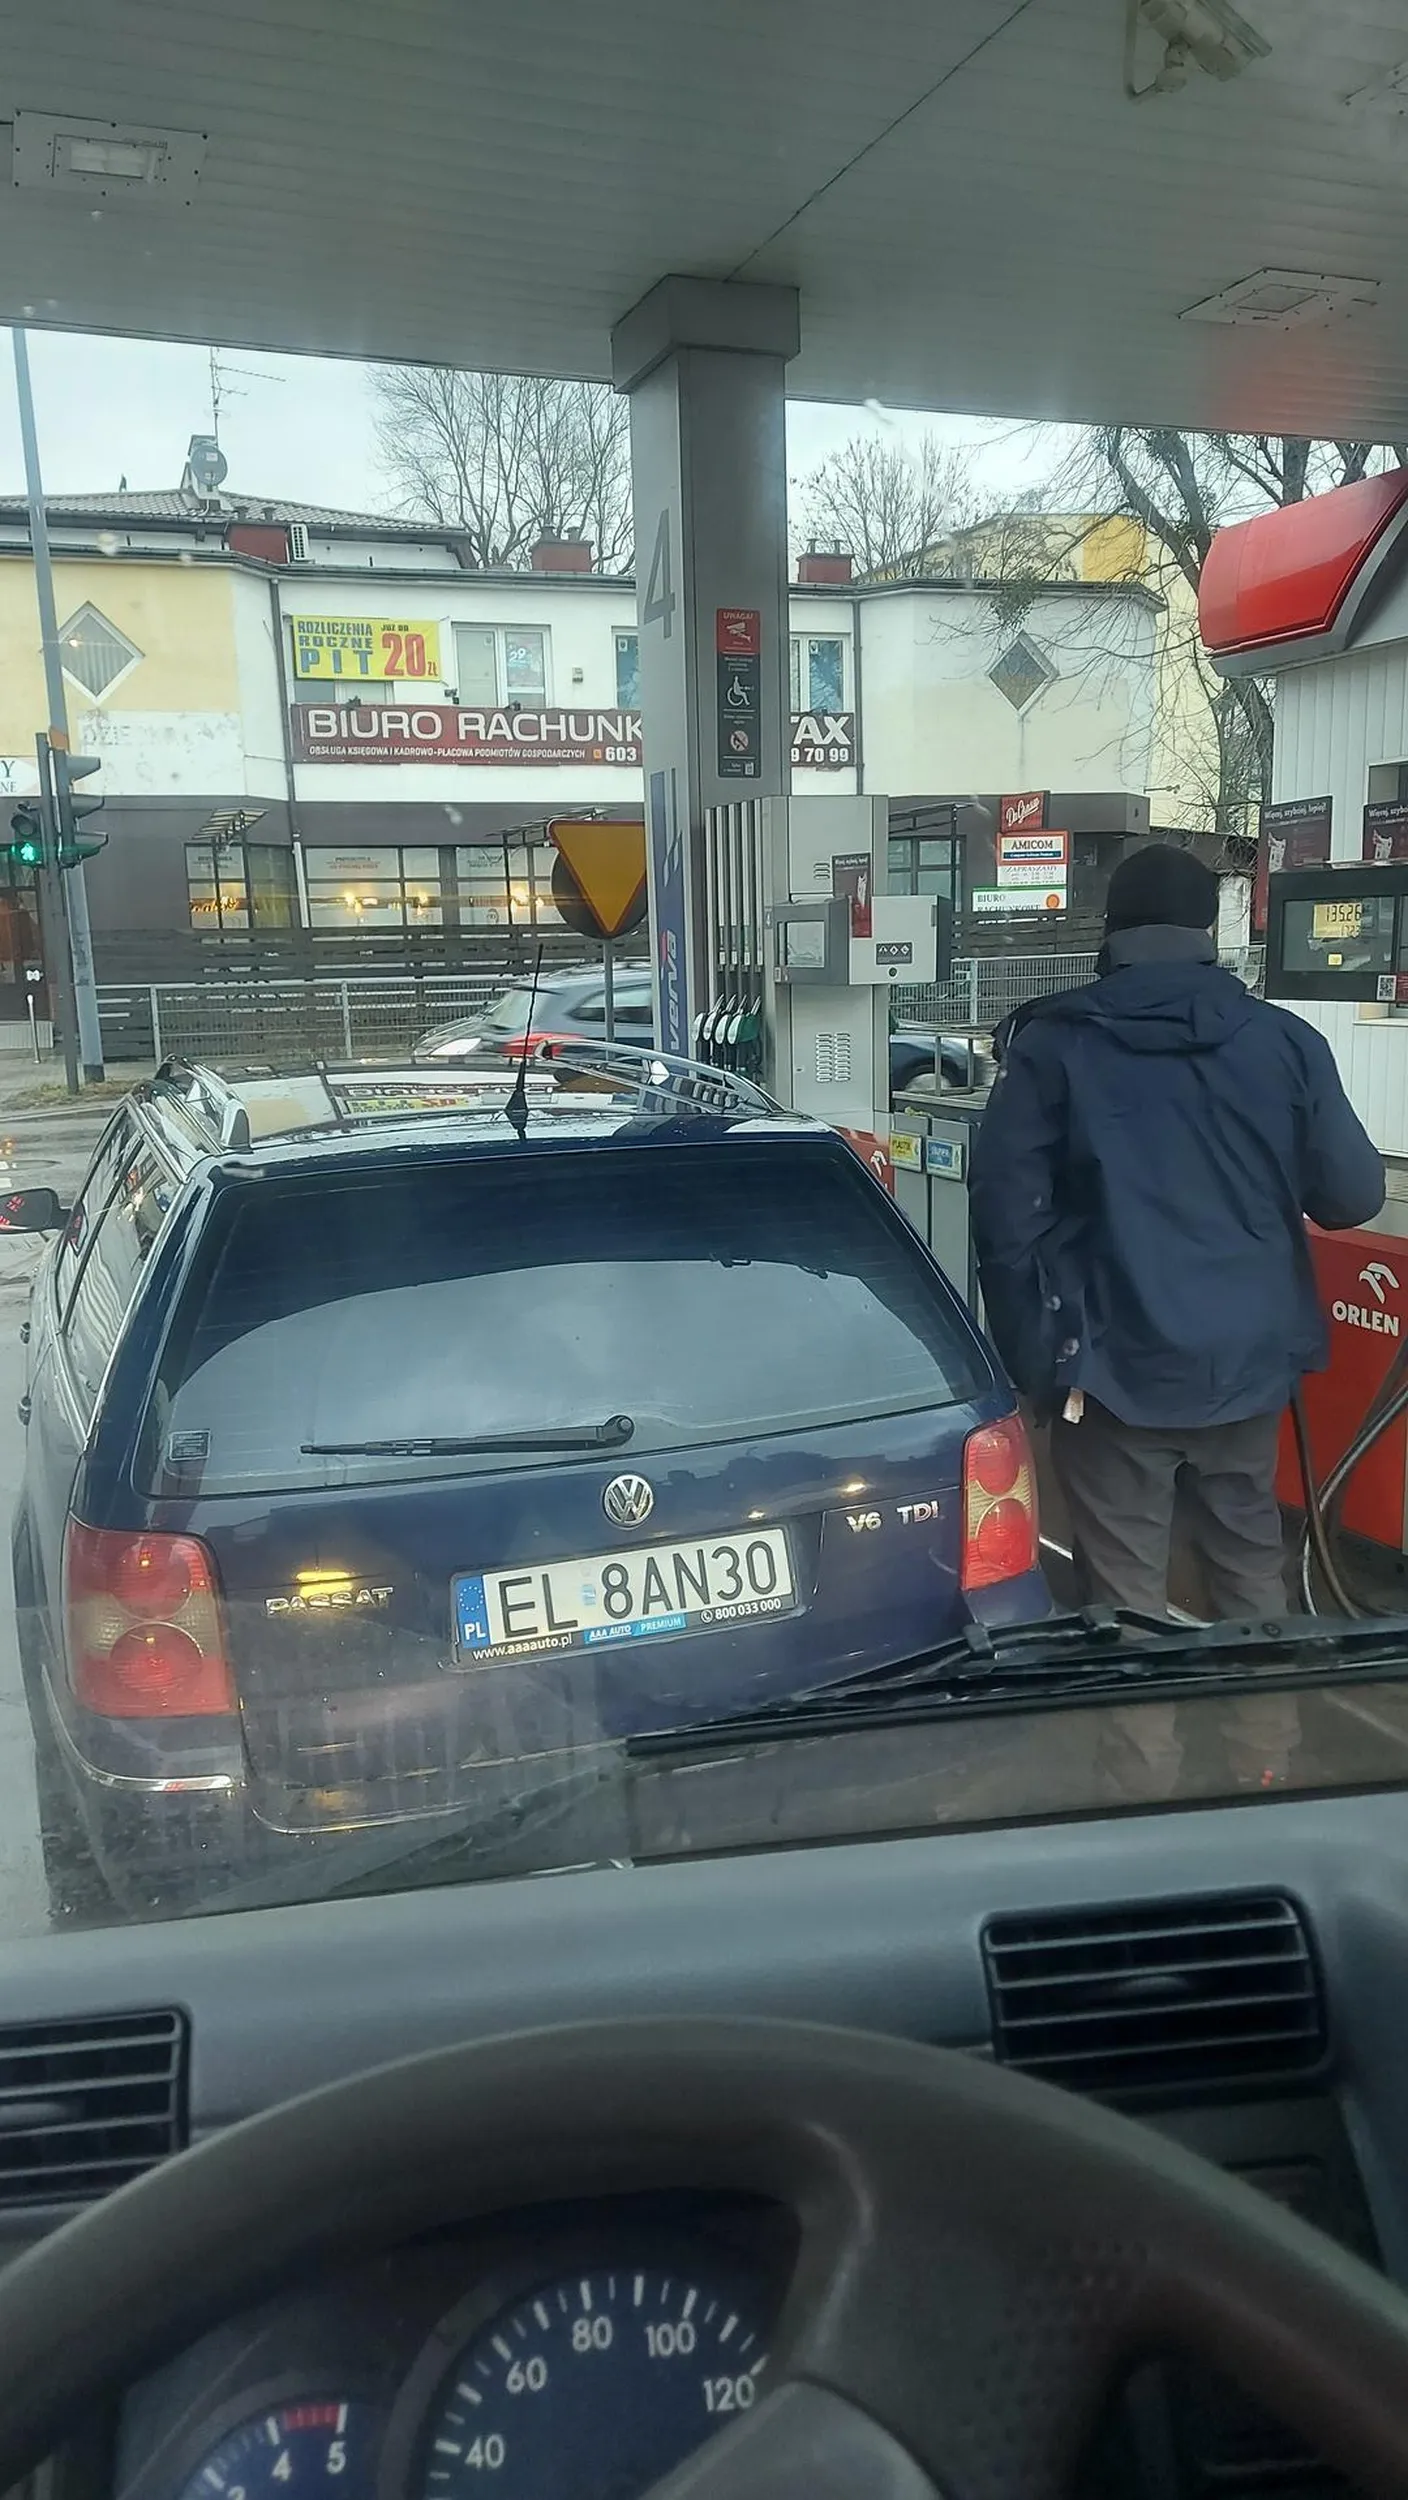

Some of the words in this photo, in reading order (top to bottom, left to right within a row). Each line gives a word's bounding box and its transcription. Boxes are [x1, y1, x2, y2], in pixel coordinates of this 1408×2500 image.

[643, 506, 675, 640] 4
[297, 620, 373, 636] ROZLICZENIA
[298, 635, 373, 648] ROCZNE
[300, 648, 373, 675] PIT
[382, 632, 426, 676] 20
[308, 709, 443, 740] BIURO
[457, 712, 643, 742] RACHUNK
[522, 749, 585, 759] GOSPODARCZYCH
[605, 746, 637, 761] 603
[804, 747, 824, 762] 70
[829, 747, 849, 762] 99
[1011, 840, 1053, 849] AMICOM
[977, 893, 1006, 902] BIURO
[1332, 1300, 1399, 1337] ORLEN
[846, 1511, 881, 1533] V6
[896, 1500, 938, 1525] TDI
[498, 1573, 578, 1638] EL
[601, 1540, 777, 1620] 8AN30
[640, 1616, 681, 1633] PREMIUM
[715, 1606, 737, 1620] 800
[737, 1602, 759, 1617] 033
[760, 1598, 782, 1613] 000
[464, 1622, 487, 1640] PL
[472, 1632, 573, 1661] www.aaaauto.pl
[589, 1627, 609, 1639] AAA
[609, 1624, 632, 1637] AUTO
[572, 2315, 613, 2353] 80
[645, 2319, 696, 2358] 100
[505, 2356, 547, 2394] 60
[703, 2374, 755, 2413] 120
[271, 2449, 292, 2482] 4
[326, 2440, 346, 2475] 5
[464, 2433, 505, 2471] 40
